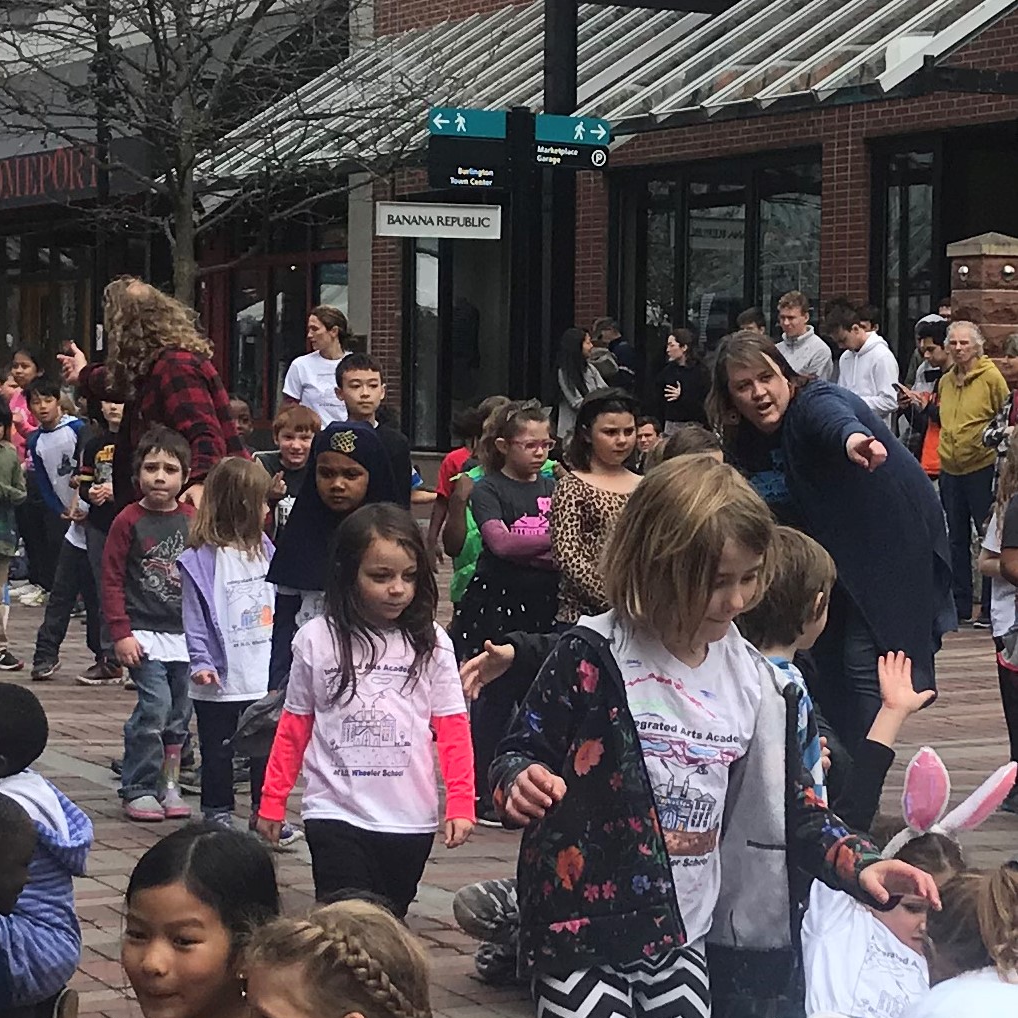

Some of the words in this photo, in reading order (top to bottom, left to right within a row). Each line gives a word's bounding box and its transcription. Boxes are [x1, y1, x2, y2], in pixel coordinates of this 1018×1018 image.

[537, 145, 579, 156] Marketplace
[536, 154, 561, 165] Garage
[457, 166, 494, 177] Burlington
[449, 176, 469, 185] Town
[469, 177, 493, 186] Center
[387, 214, 435, 226] BANANA
[436, 215, 491, 228] REPUBLIC
[680, 726, 703, 740] Arts
[351, 769, 381, 777] Wheeler
[382, 768, 404, 777] School
